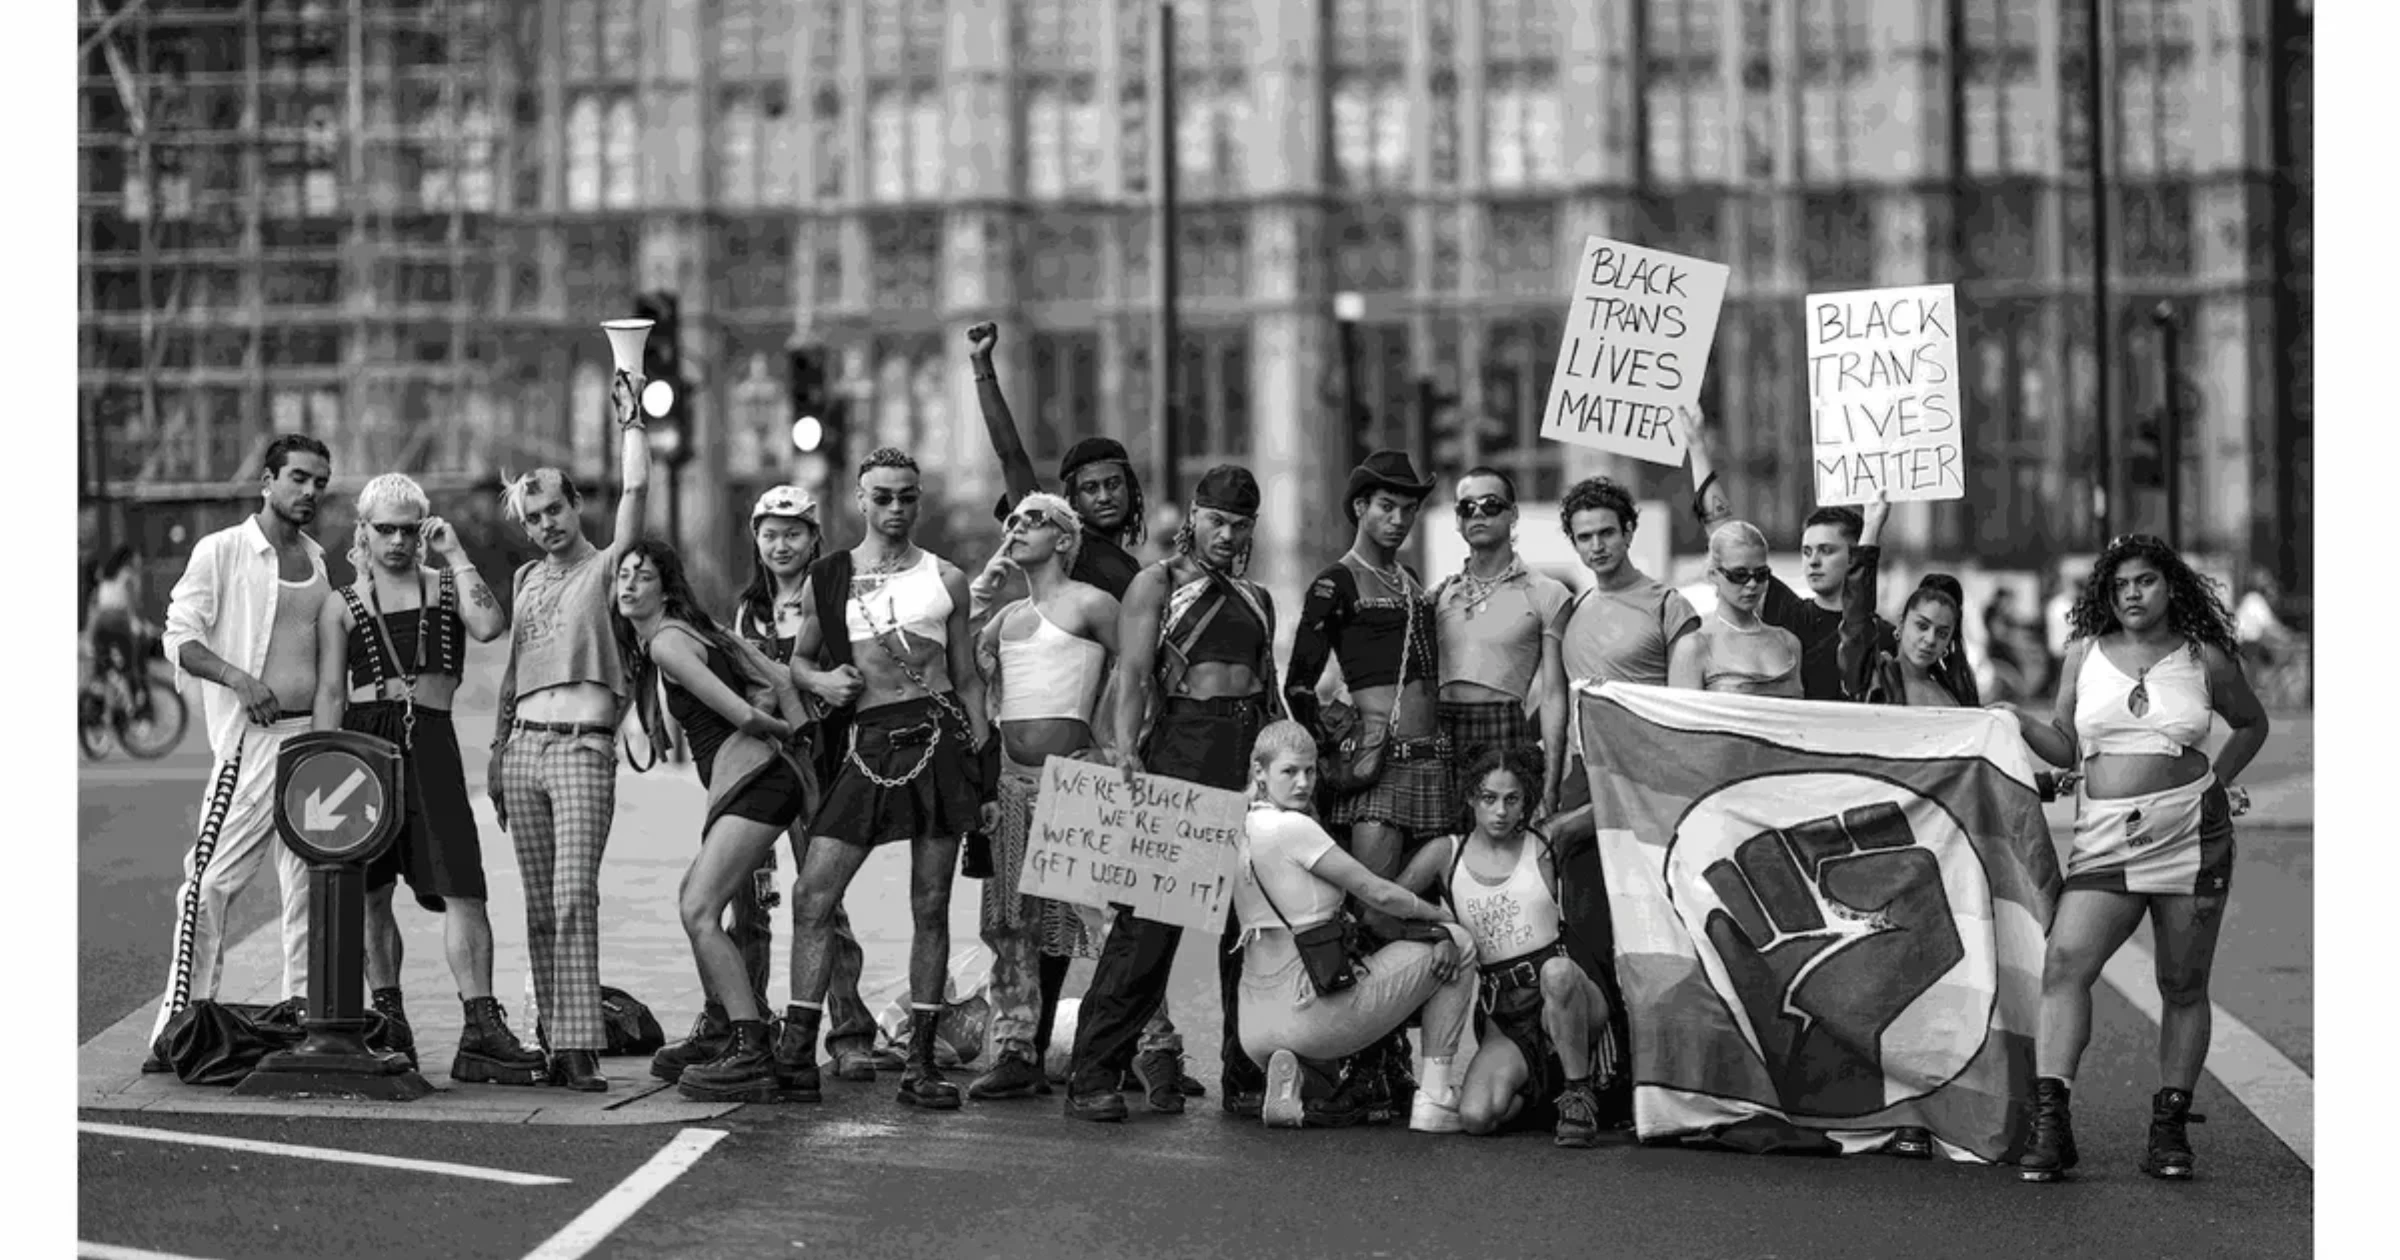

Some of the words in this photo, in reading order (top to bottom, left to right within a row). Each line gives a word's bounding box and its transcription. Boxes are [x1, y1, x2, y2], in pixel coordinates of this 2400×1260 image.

[1591, 247, 1688, 298] BLACK
[1586, 297, 1686, 338] TRANS
[1817, 299, 1949, 344] BLACK
[1810, 343, 1947, 396] TRANS
[1556, 389, 1675, 446] MATTER
[1815, 396, 1953, 446] LIVES
[1816, 444, 1963, 497] MATTER
[1054, 768, 1120, 804] WE'RE
[1131, 777, 1201, 815] BLACK
[1043, 821, 1112, 854] WE'RE
[1131, 836, 1182, 863] HERE
[1098, 804, 1163, 835] WE'RE
[1176, 819, 1239, 849] QUEER
[1032, 850, 1077, 884] GET
[1091, 861, 1137, 888] USED
[1152, 873, 1177, 894] TO
[1466, 890, 1510, 913] BLACK
[1471, 900, 1521, 927] TRANS
